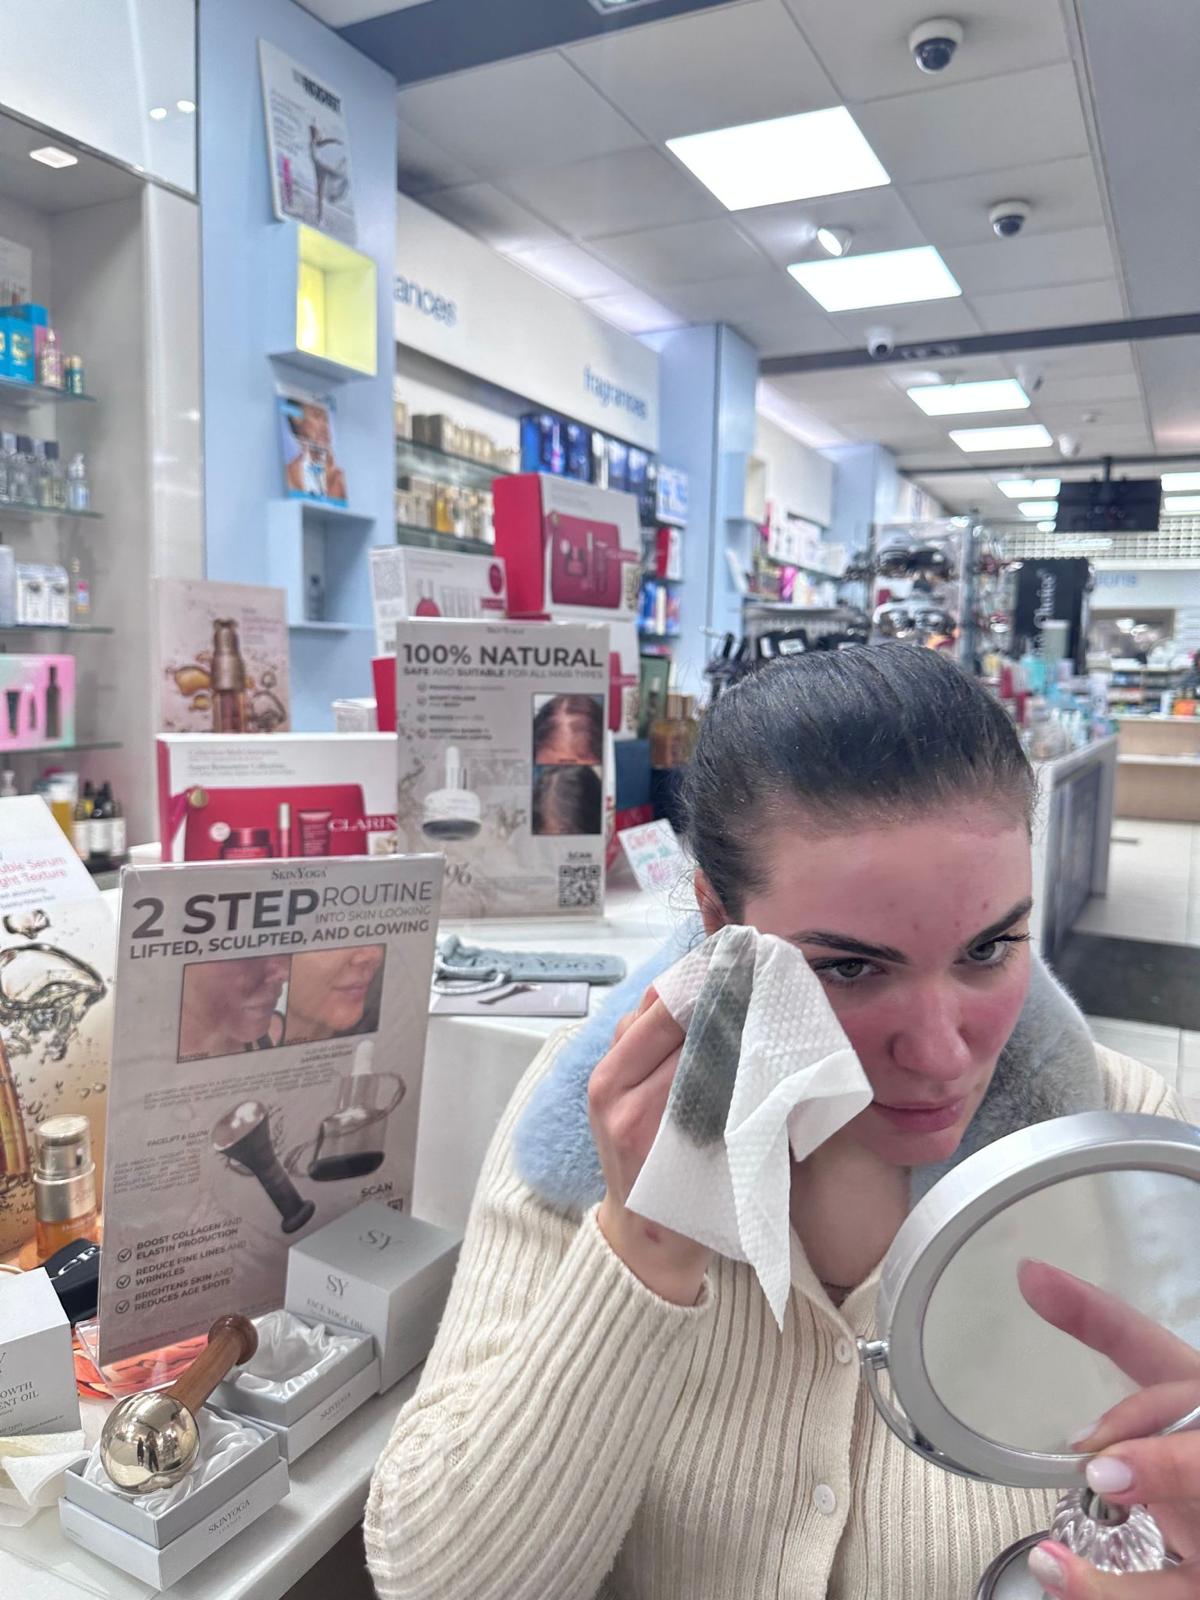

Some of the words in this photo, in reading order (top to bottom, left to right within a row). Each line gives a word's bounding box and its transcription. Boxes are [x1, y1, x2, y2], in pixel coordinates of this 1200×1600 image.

[583, 365, 647, 420] fragrances
[403, 643, 472, 665] 100%
[479, 646, 604, 668] NATURAL
[403, 668, 430, 677] SAFE
[432, 668, 456, 677] AND
[457, 669, 505, 678] SUITABLE
[507, 669, 528, 679] FOR
[530, 670, 549, 679] ALL
[550, 670, 573, 680] HAIR
[576, 671, 604, 680] TYPES
[132, 897, 164, 939] 2
[182, 887, 320, 935] STEP
[321, 881, 433, 907] ROUTINE
[316, 911, 344, 924] INTO
[348, 908, 376, 922] SKIN
[379, 905, 431, 919] LOOKING
[130, 940, 203, 959] LIFTED,
[209, 931, 308, 952] SCULPTED,
[312, 924, 349, 942] AND
[354, 919, 429, 938] GLOWING
[147, 1134, 180, 1147] FACELIFT
[361, 1182, 393, 1197] SCAN
[136, 1244, 176, 1260] ELASTIN
[177, 1228, 239, 1249] PRODUCTION
[137, 1235, 169, 1250] BOOST
[172, 1223, 221, 1241] COLLAGEN
[222, 1217, 242, 1228] AND
[136, 1259, 175, 1276] REDUCE
[177, 1253, 198, 1264] FINE
[200, 1247, 225, 1259] LINES
[227, 1240, 247, 1251] AND
[134, 1281, 188, 1301] BRIGHTENS
[190, 1274, 212, 1286] SKIN
[213, 1267, 234, 1279] AND
[136, 1267, 186, 1287] WRINKLES
[326, 1274, 349, 1296] SY
[134, 1293, 179, 1311] REDUCES
[181, 1287, 200, 1298] AGE
[202, 1278, 231, 1292] SPOTS
[21, 1390, 39, 1402] OIL
[208, 1500, 250, 1533] SKINYOGA
